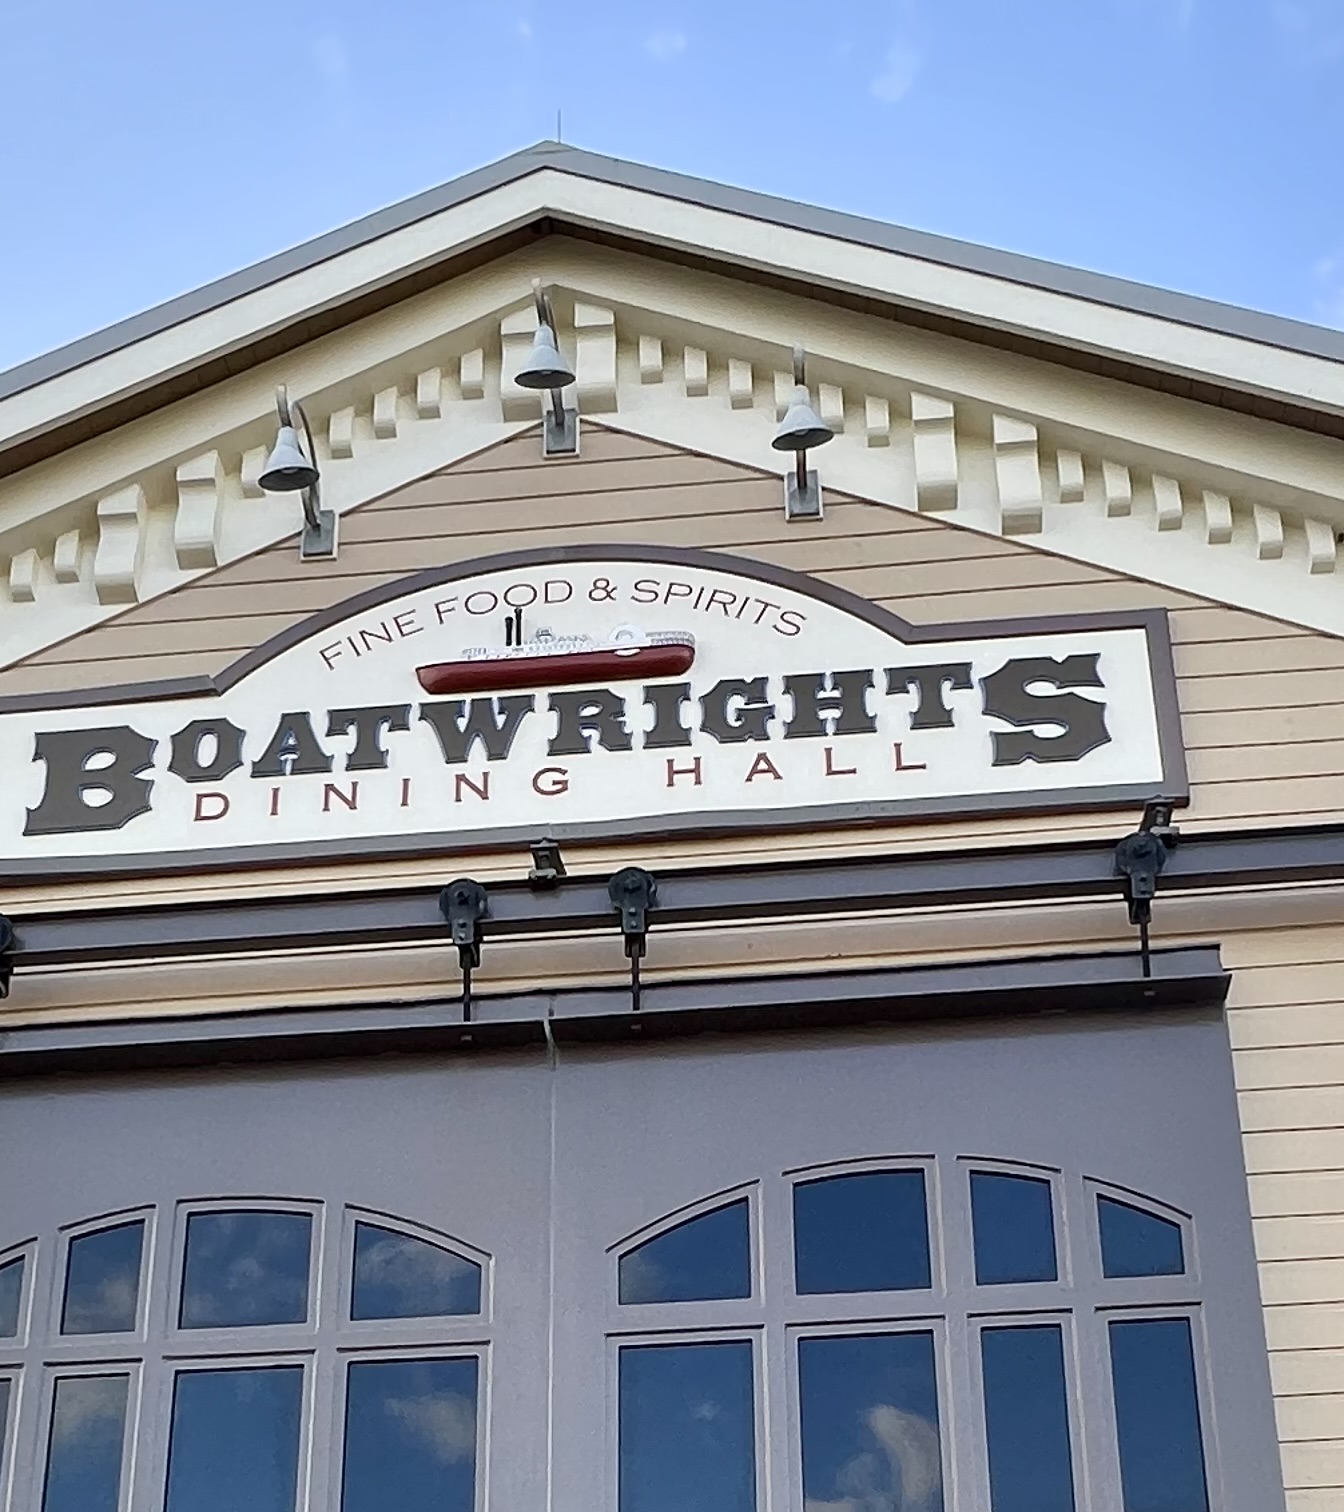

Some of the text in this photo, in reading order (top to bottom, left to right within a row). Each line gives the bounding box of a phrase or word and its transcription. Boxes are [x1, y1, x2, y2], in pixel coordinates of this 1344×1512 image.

[318, 576, 807, 672] FINE FOOD & SPIRITS
[22, 652, 1112, 837] BOATWRIGHTS
[192, 742, 927, 822] DINING HALL
